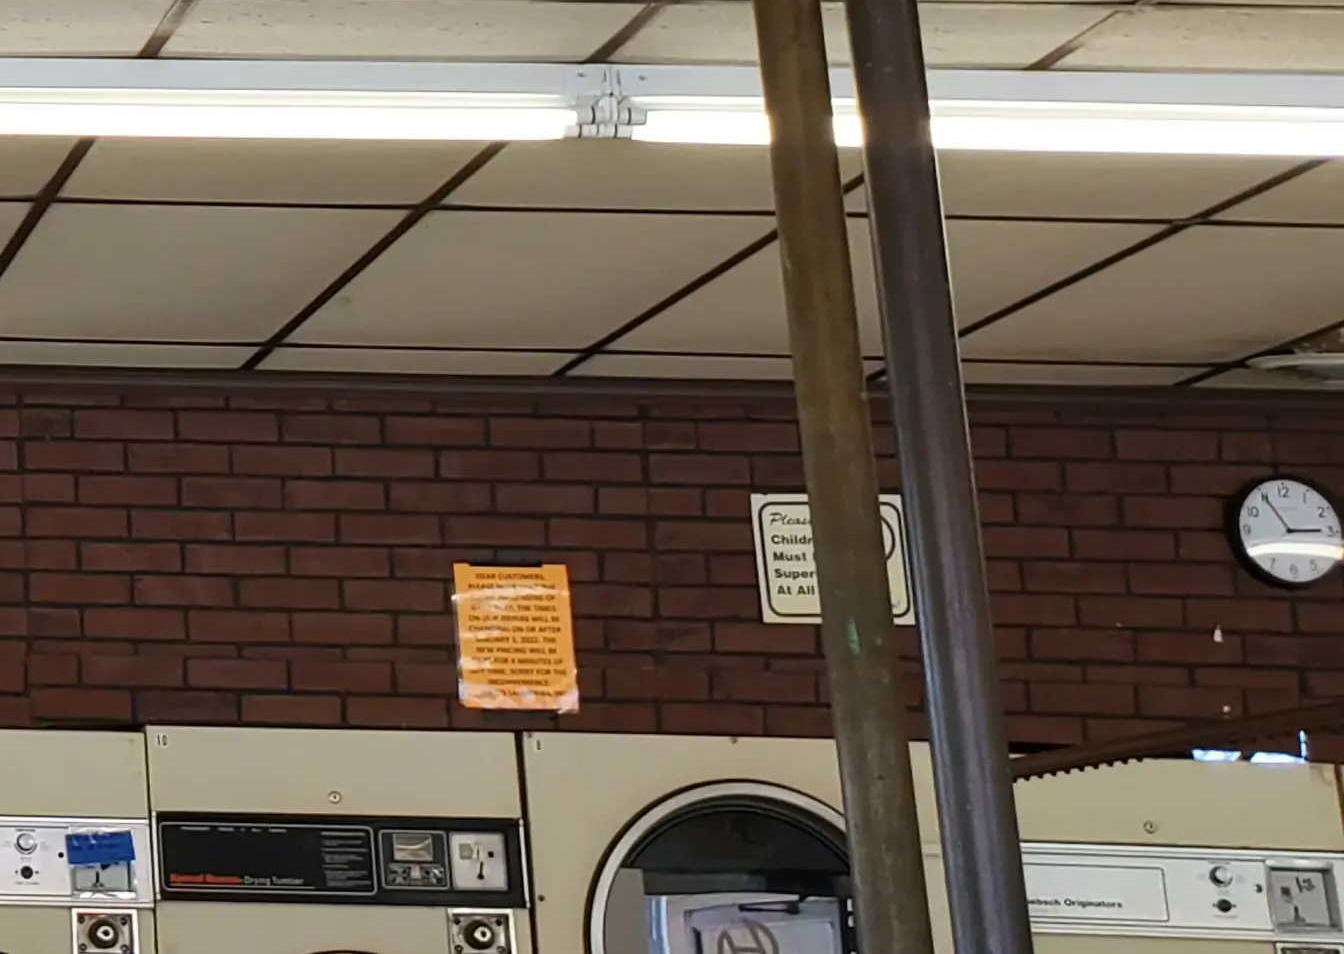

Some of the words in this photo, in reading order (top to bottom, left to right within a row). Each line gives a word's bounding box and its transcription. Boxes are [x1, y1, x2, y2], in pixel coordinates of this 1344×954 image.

[1277, 486, 1290, 498] 12
[1248, 506, 1259, 518] 10
[1317, 506, 1326, 518] 2
[771, 534, 813, 545] Childr
[773, 552, 807, 562] Must
[1269, 557, 1276, 569] 7
[1309, 558, 1318, 571] 5
[774, 568, 814, 580] Super
[777, 585, 792, 595] At
[797, 585, 815, 596] All
